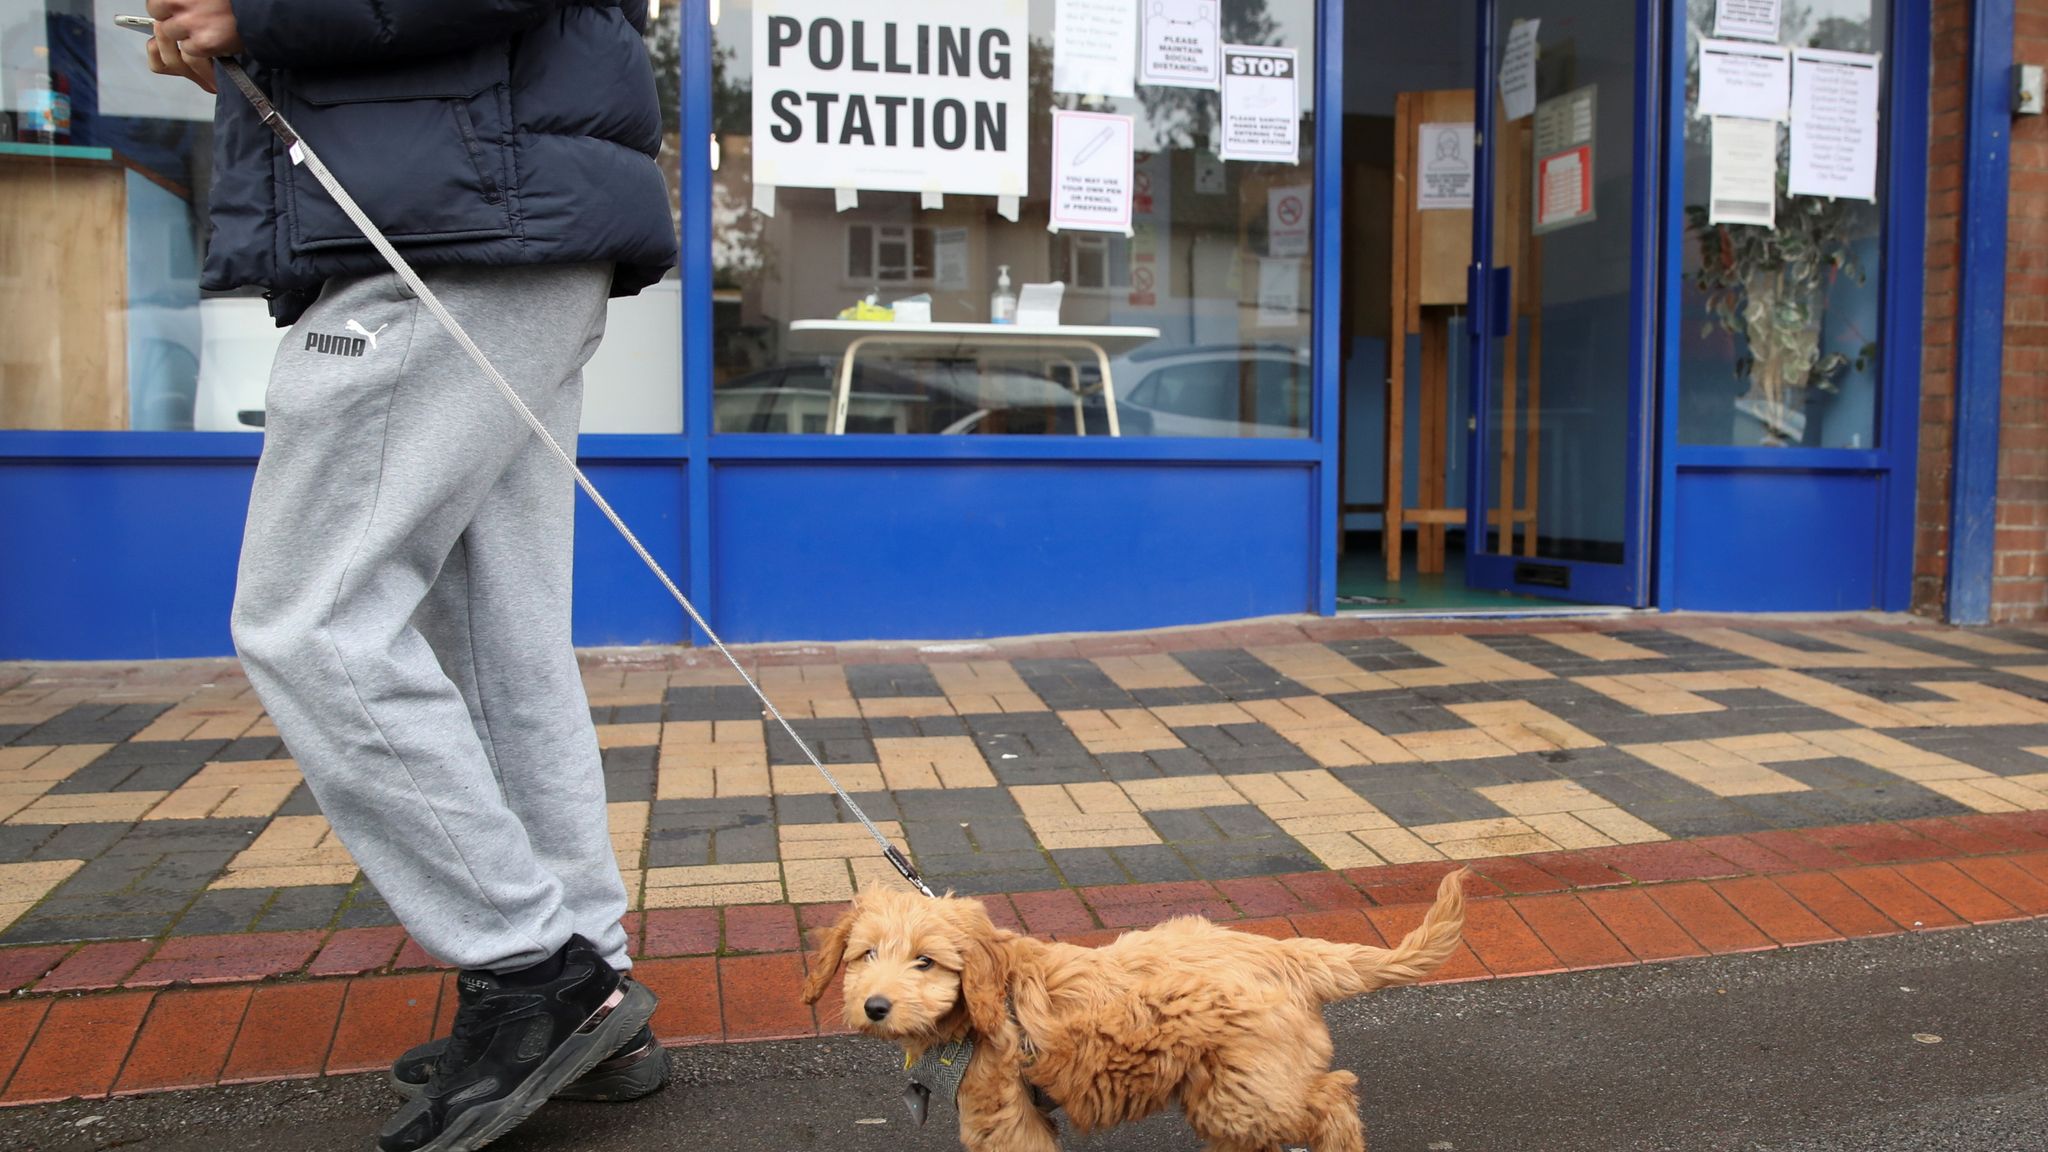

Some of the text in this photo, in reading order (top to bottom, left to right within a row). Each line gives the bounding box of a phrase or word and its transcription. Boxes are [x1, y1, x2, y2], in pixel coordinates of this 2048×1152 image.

[1164, 36, 1198, 45] PLEASE
[768, 15, 1011, 80] POLLING
[1159, 44, 1203, 54] MAINTAIN
[1165, 54, 1197, 63] SOCIAL
[1153, 61, 1209, 73] DISTANCING
[1231, 56, 1289, 77] STOP
[770, 89, 1007, 152] STATION
[1262, 138, 1292, 146] STATION
[1084, 195, 1112, 203] PENCIL
[305, 332, 366, 357] PUMA
